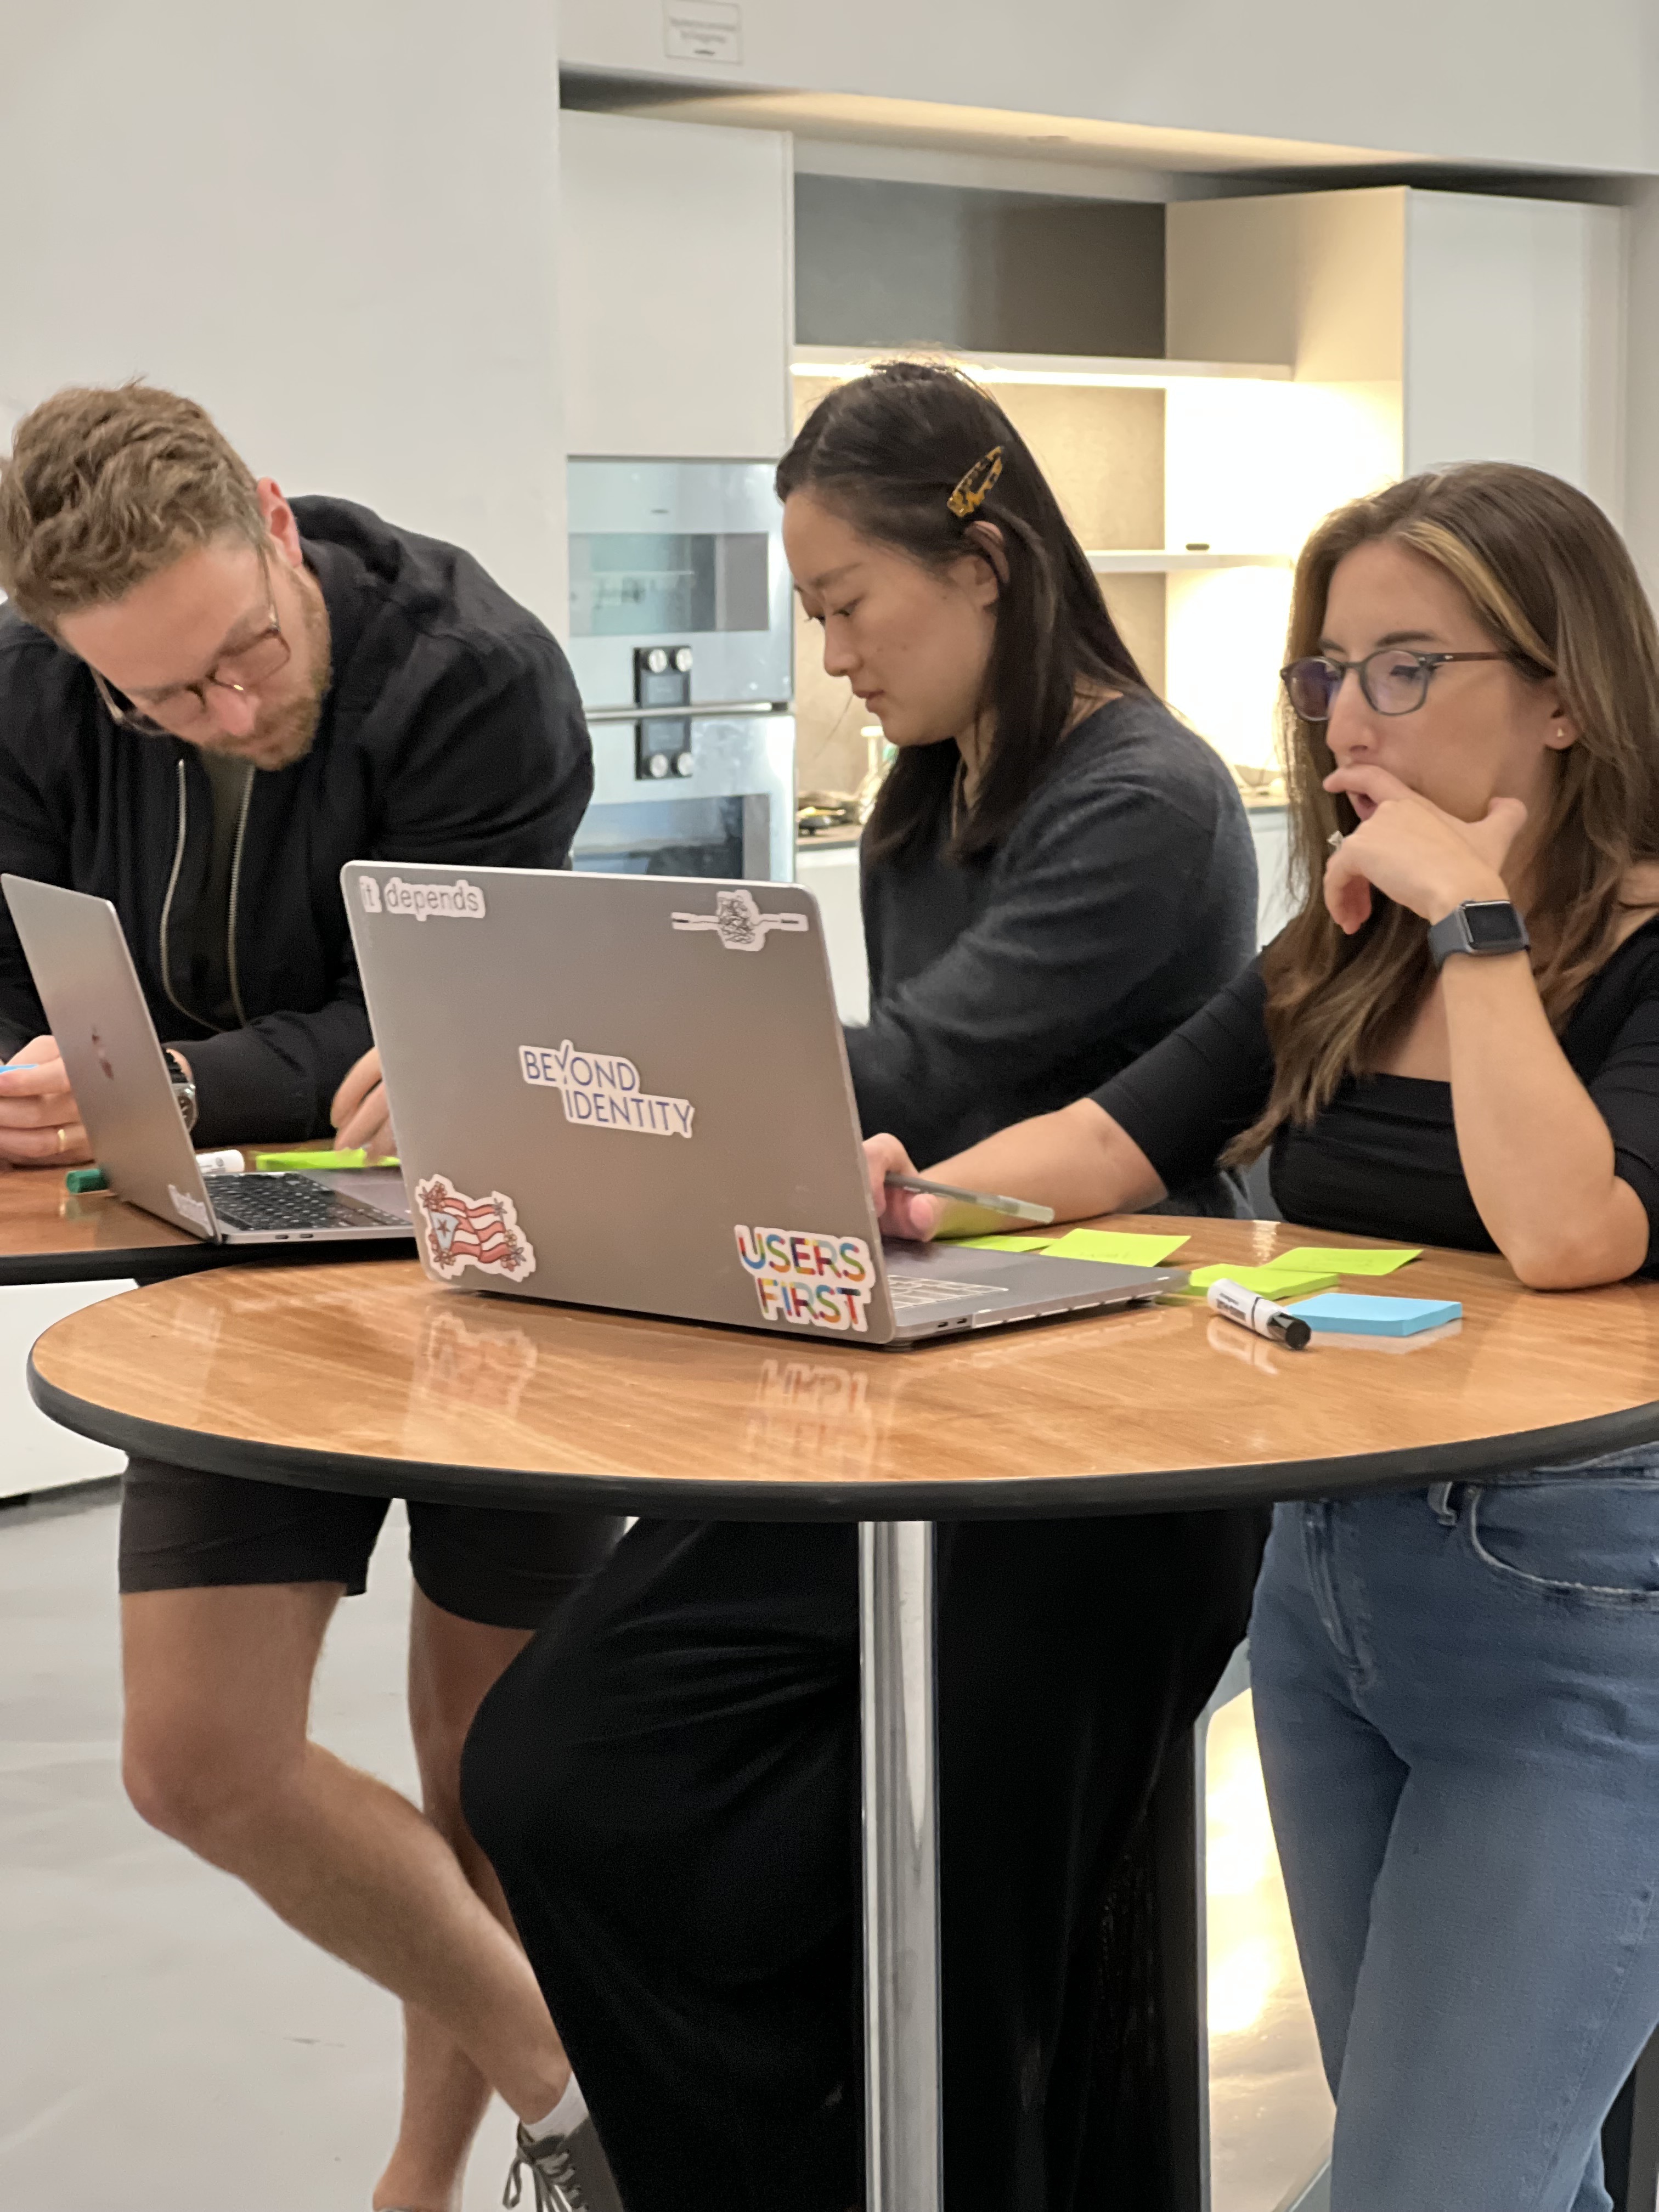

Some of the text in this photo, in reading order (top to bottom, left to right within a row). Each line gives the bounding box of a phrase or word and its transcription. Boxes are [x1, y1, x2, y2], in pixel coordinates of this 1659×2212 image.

[386, 883, 479, 914] depends
[524, 1044, 636, 1091] BEYOND
[565, 1090, 691, 1133] IDENTITY
[738, 1233, 867, 1282] USERS
[757, 1277, 862, 1325] FIRST
